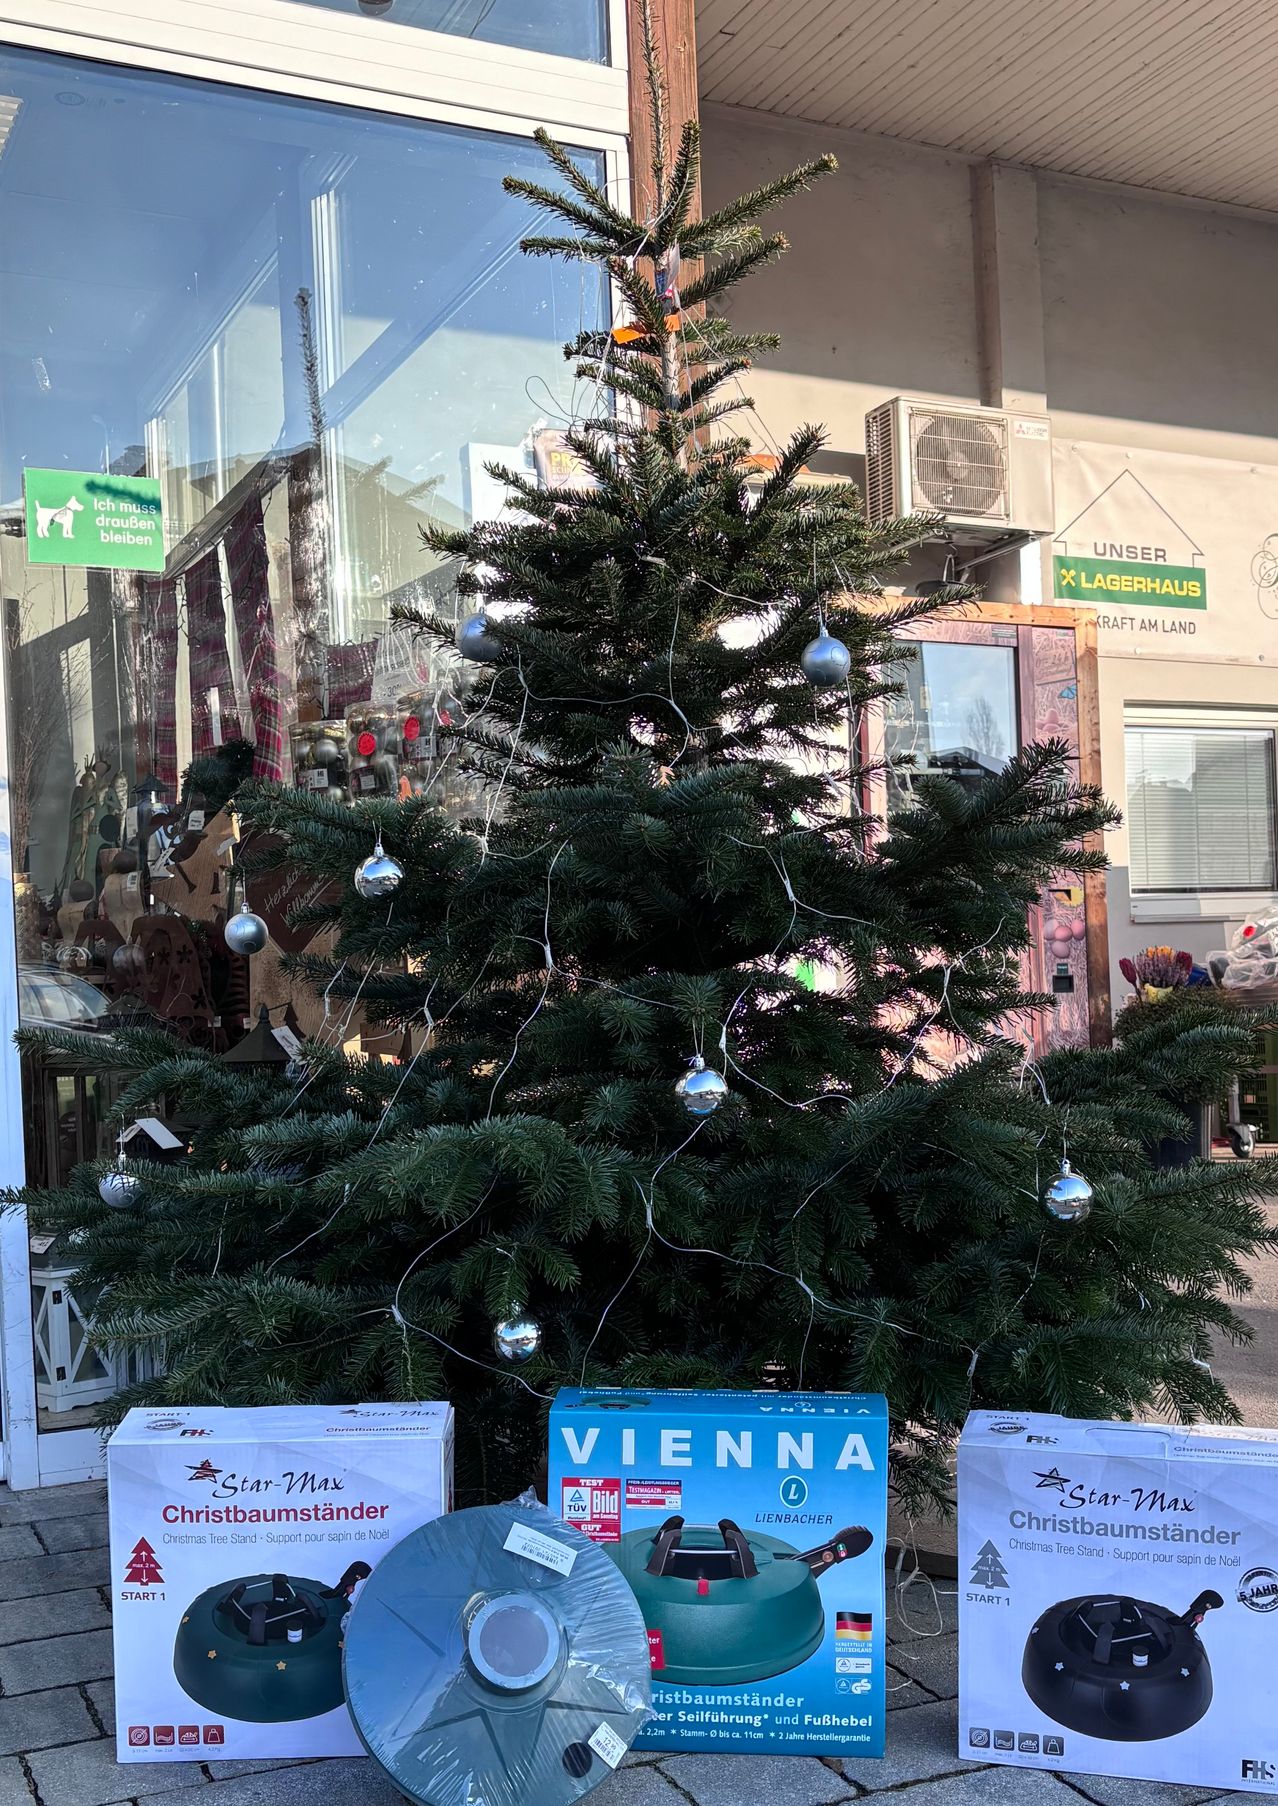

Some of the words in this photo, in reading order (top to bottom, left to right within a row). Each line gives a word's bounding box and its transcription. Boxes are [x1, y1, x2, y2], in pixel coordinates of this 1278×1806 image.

[93, 498, 116, 512] Ich
[120, 502, 156, 515] muss
[95, 514, 156, 530] draußen
[100, 530, 153, 546] bleiben
[1093, 541, 1167, 562] UNSER
[1080, 571, 1201, 597] LAGERHAUS
[1139, 618, 1158, 633] AM
[1162, 619, 1196, 635] LAND
[759, 1406, 871, 1414] VIENNA
[561, 1427, 875, 1471] VIENNA
[1173, 1446, 1278, 1458] Christbaumstände
[212, 1471, 345, 1499] Star-Max
[788, 1484, 799, 1500] L
[592, 1490, 619, 1514] Bild
[1060, 1484, 1196, 1512] Star-Max
[162, 1501, 389, 1523] Christbaumständer
[567, 1503, 587, 1512] TÜV
[755, 1513, 833, 1524] LIENBACHER
[1009, 1510, 1241, 1545] Christbaumständer
[162, 1533, 207, 1545] Christmas
[208, 1533, 229, 1544] Tree
[231, 1532, 257, 1544] Stand
[266, 1532, 301, 1545] Support
[305, 1533, 324, 1544] pour
[328, 1531, 352, 1544] sapin
[355, 1531, 366, 1540] de
[369, 1529, 390, 1540] Noël
[1009, 1538, 1053, 1553] Christmas
[1056, 1542, 1075, 1555] Tree
[1077, 1545, 1104, 1558] Stand
[1113, 1548, 1150, 1562] Support
[1153, 1553, 1174, 1564] pour
[1176, 1554, 1202, 1567] sapin
[1204, 1554, 1217, 1565] de
[1219, 1555, 1241, 1567] Noël
[121, 1592, 157, 1600] START
[160, 1592, 165, 1600] 1
[966, 1592, 1002, 1605] START
[1004, 1597, 1010, 1606] 1
[1249, 1583, 1278, 1599] JAHR
[652, 1690, 804, 1707] ristbaumständer
[775, 1714, 799, 1725] und
[804, 1714, 872, 1727] Fußhebel
[646, 1728, 665, 1736] 2,2m
[680, 1729, 708, 1737] Stamm-
[719, 1730, 730, 1738] bis
[744, 1731, 764, 1739] 11cm
[785, 1732, 805, 1740] Jahre
[806, 1733, 871, 1744] Herstellergarantie
[1241, 1759, 1276, 1781] FHS
